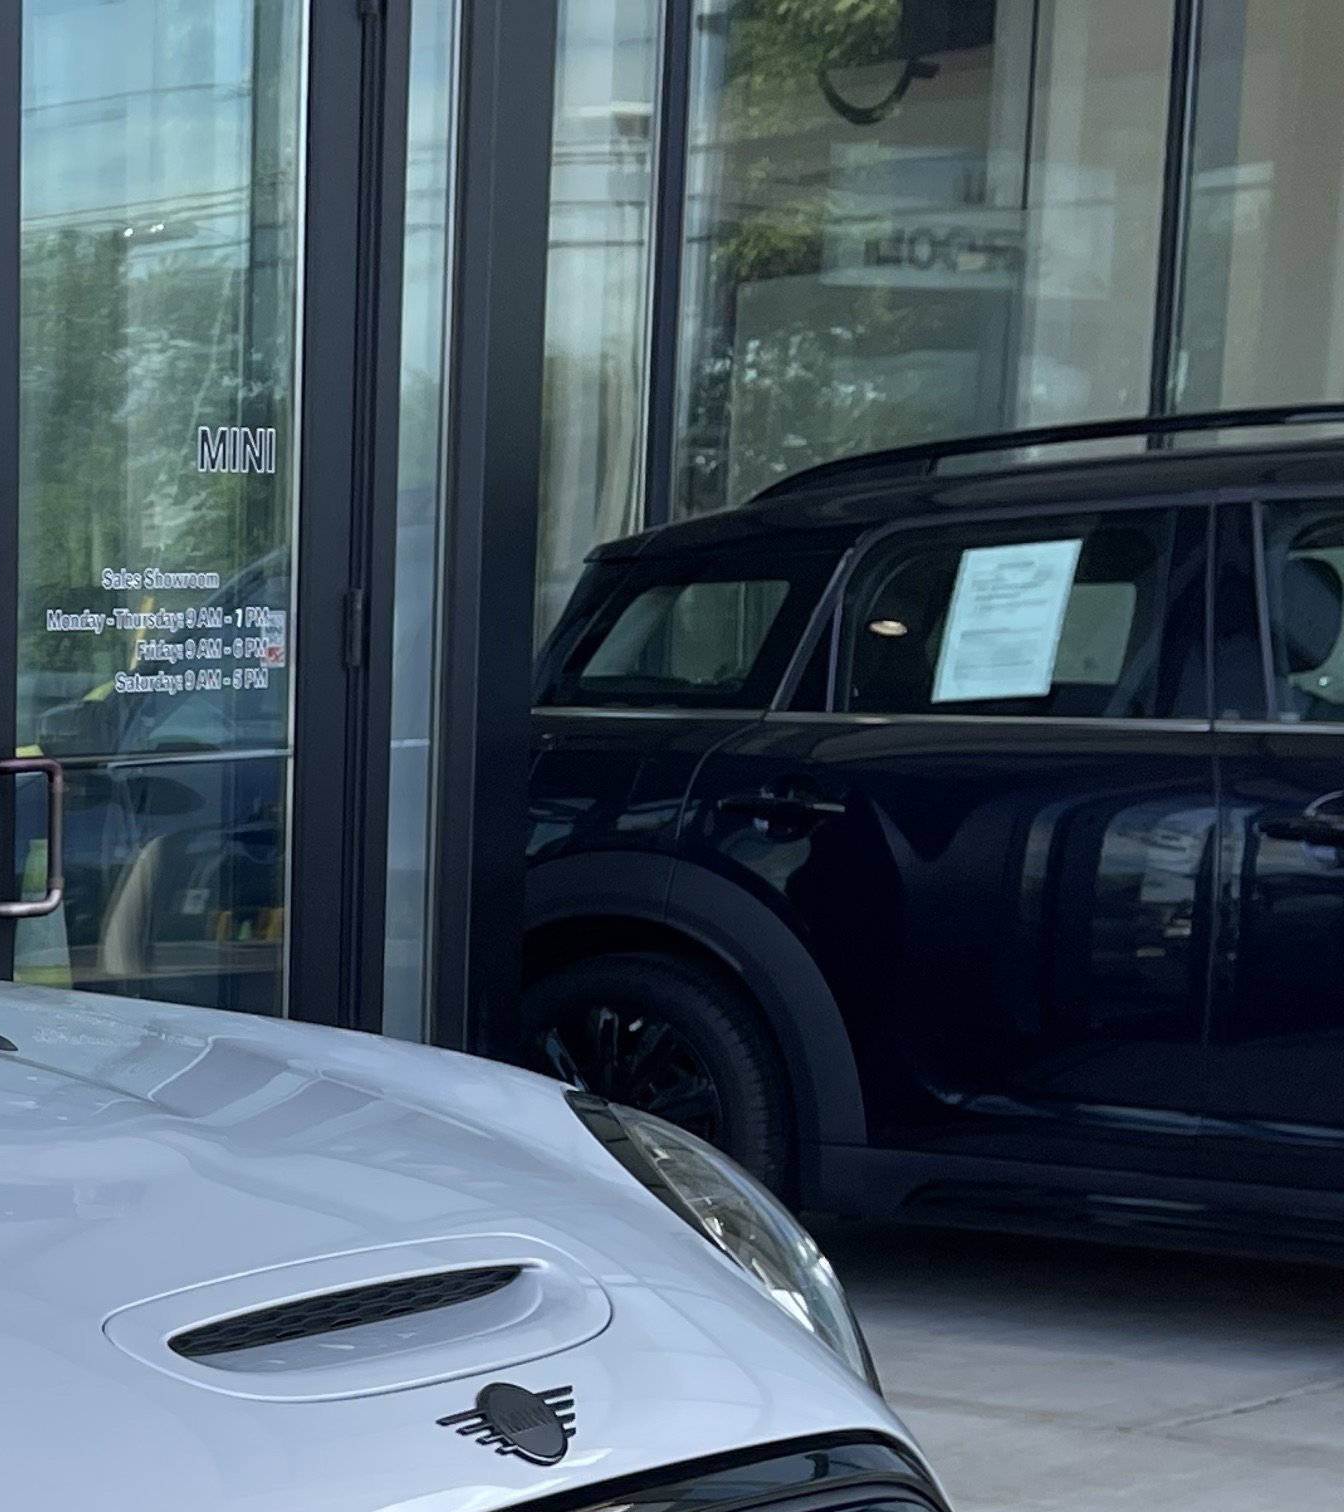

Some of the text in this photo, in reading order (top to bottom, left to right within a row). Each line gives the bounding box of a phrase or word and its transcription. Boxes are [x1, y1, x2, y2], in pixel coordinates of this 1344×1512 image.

[198, 426, 276, 473] MINI
[101, 568, 220, 590] Sales Showroom
[46, 609, 106, 635] Monday
[185, 607, 197, 629] 9
[196, 607, 223, 629] AM
[184, 638, 196, 660] 9
[196, 638, 222, 659] AM
[114, 671, 184, 696] Saturday:
[184, 669, 196, 691] 9
[195, 669, 222, 690] AM
